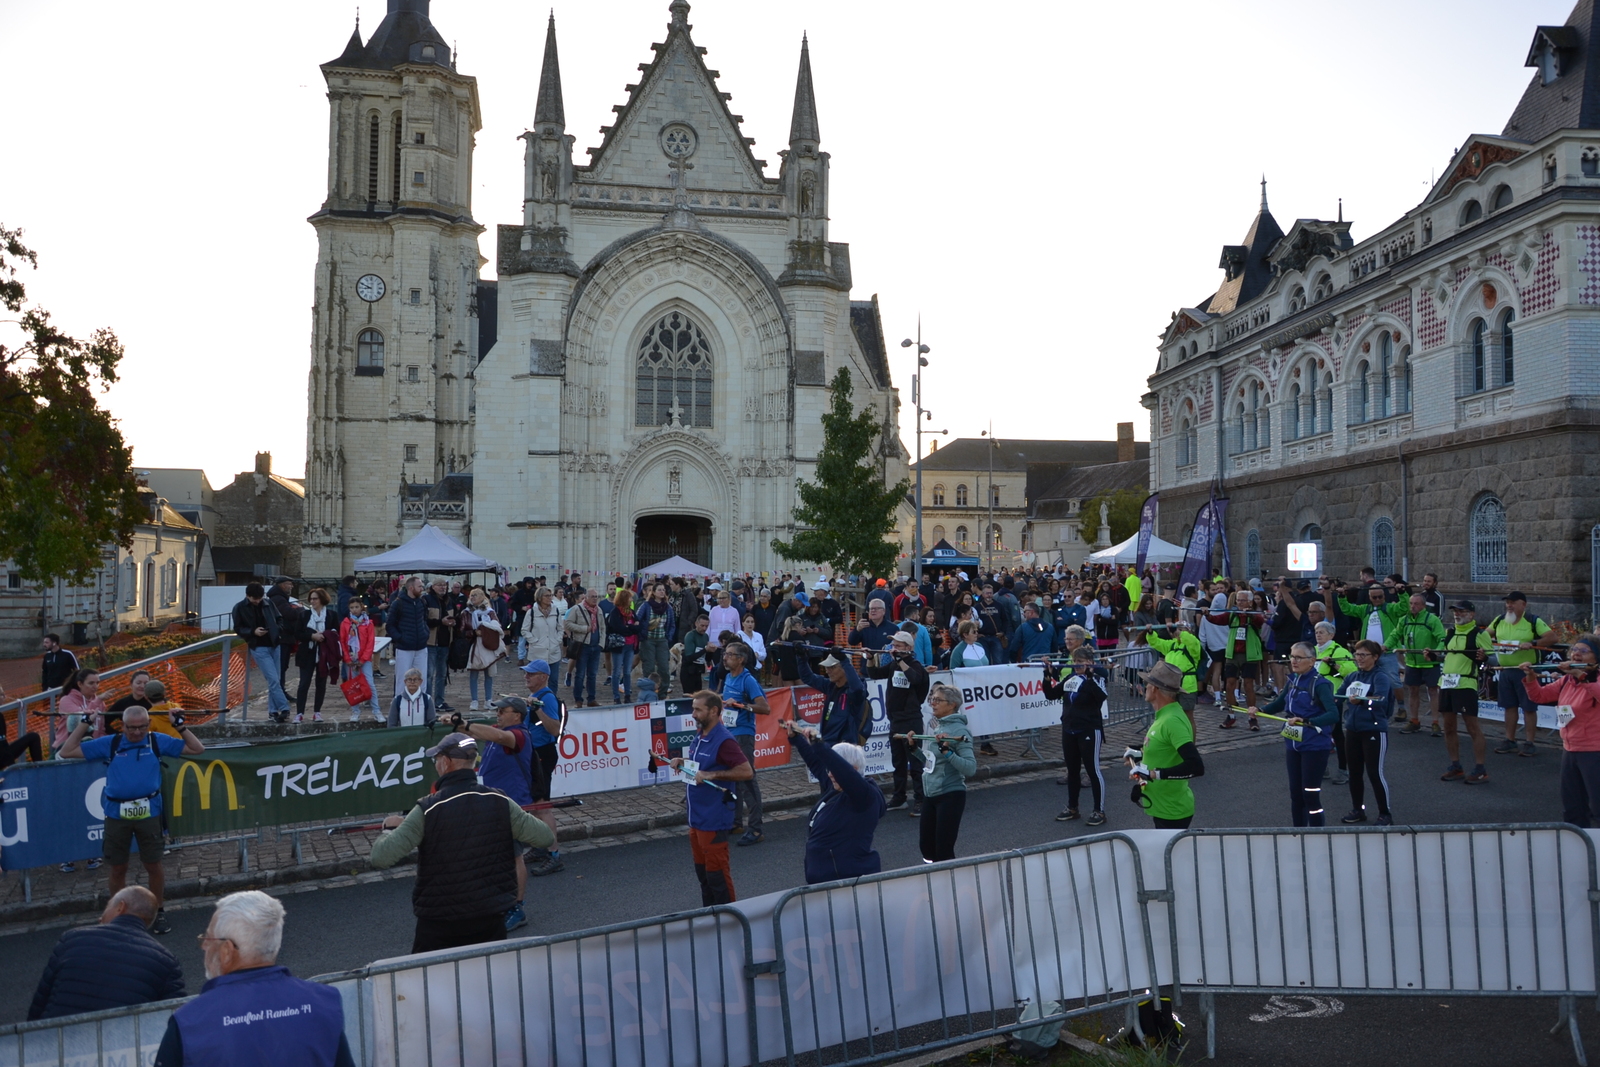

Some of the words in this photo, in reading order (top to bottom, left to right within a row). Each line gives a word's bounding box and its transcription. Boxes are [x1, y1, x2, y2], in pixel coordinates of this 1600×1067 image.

[559, 728, 629, 759] OIRE
[256, 746, 425, 799] TRÉLAZÉ
[124, 806, 147, 817] 15007
[223, 1010, 264, 1026] Beaufort
[266, 1007, 300, 1019] Randos
